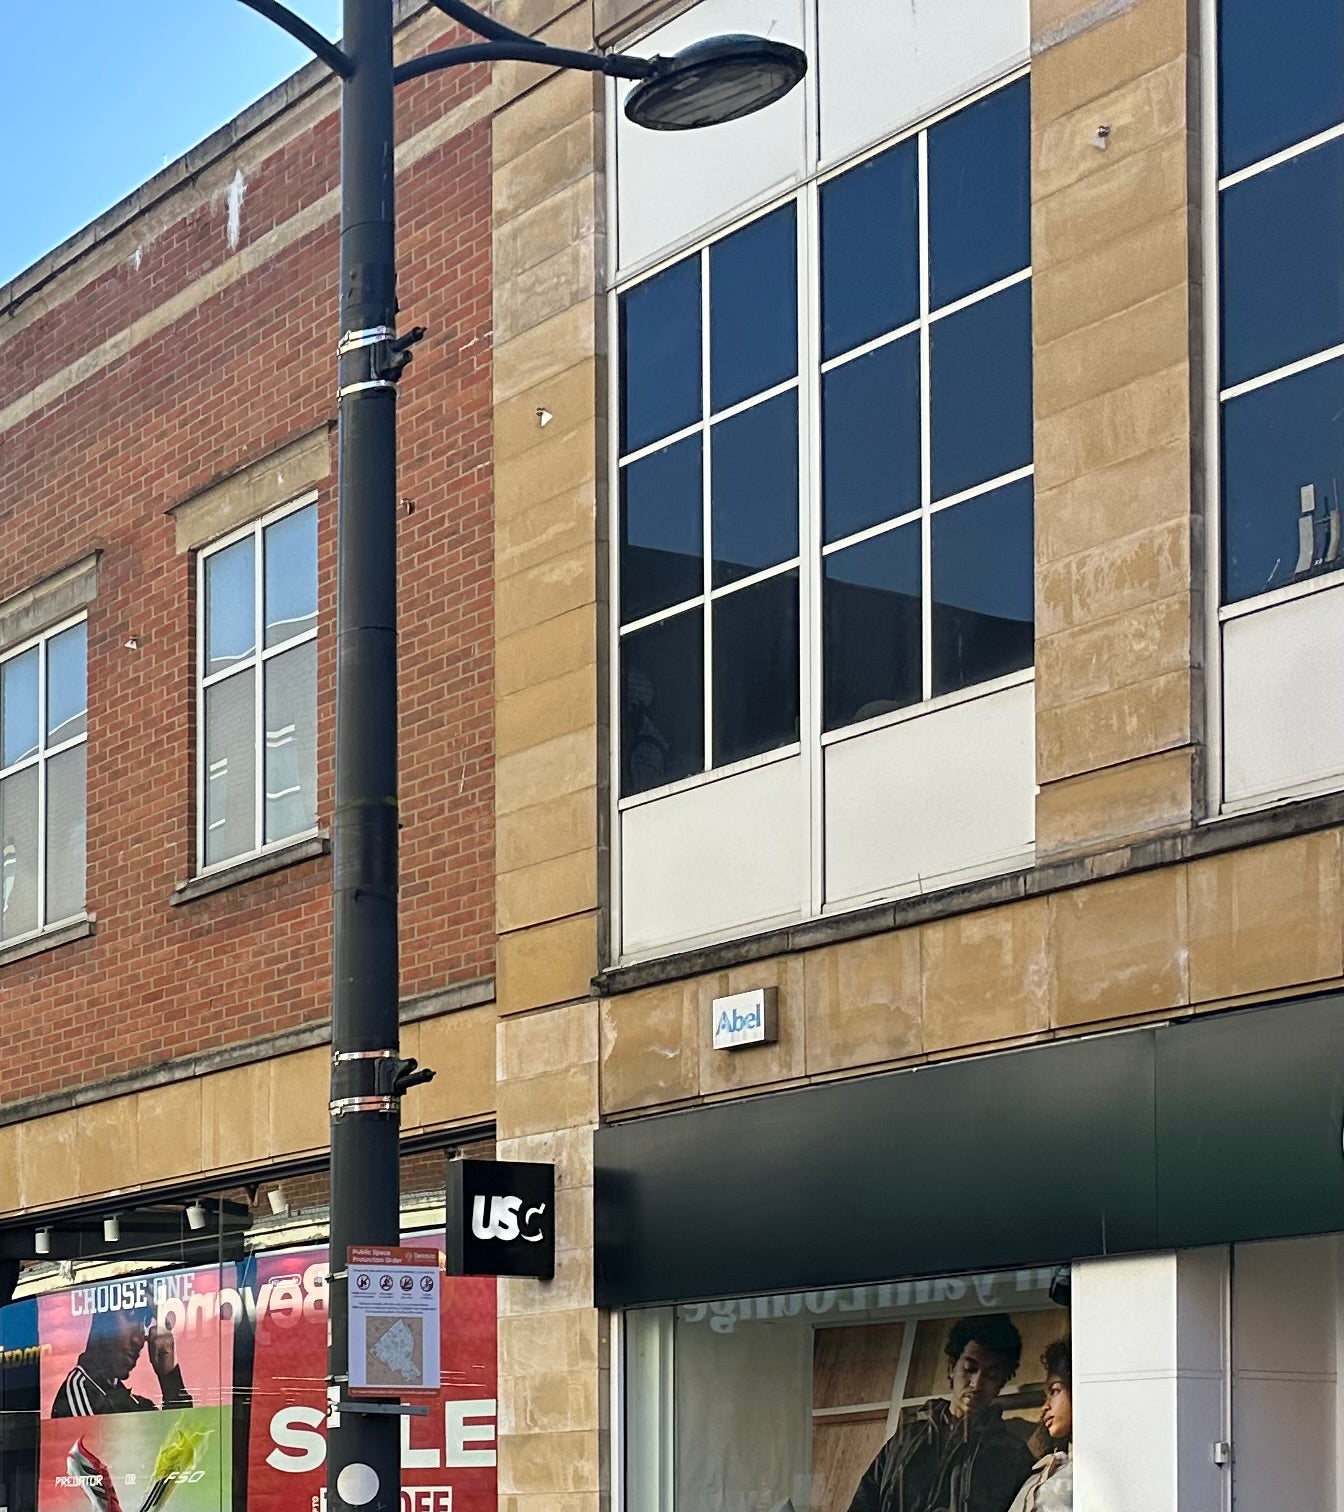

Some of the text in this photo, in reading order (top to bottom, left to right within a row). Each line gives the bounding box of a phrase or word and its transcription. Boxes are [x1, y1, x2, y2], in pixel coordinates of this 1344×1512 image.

[716, 1004, 761, 1035] Abel
[472, 1195, 546, 1242] USC
[71, 1273, 195, 1317] CHOOSE ONE
[265, 1399, 497, 1473] SLE
[55, 1474, 103, 1488] PREDATOR
[125, 1474, 136, 1485] OR
